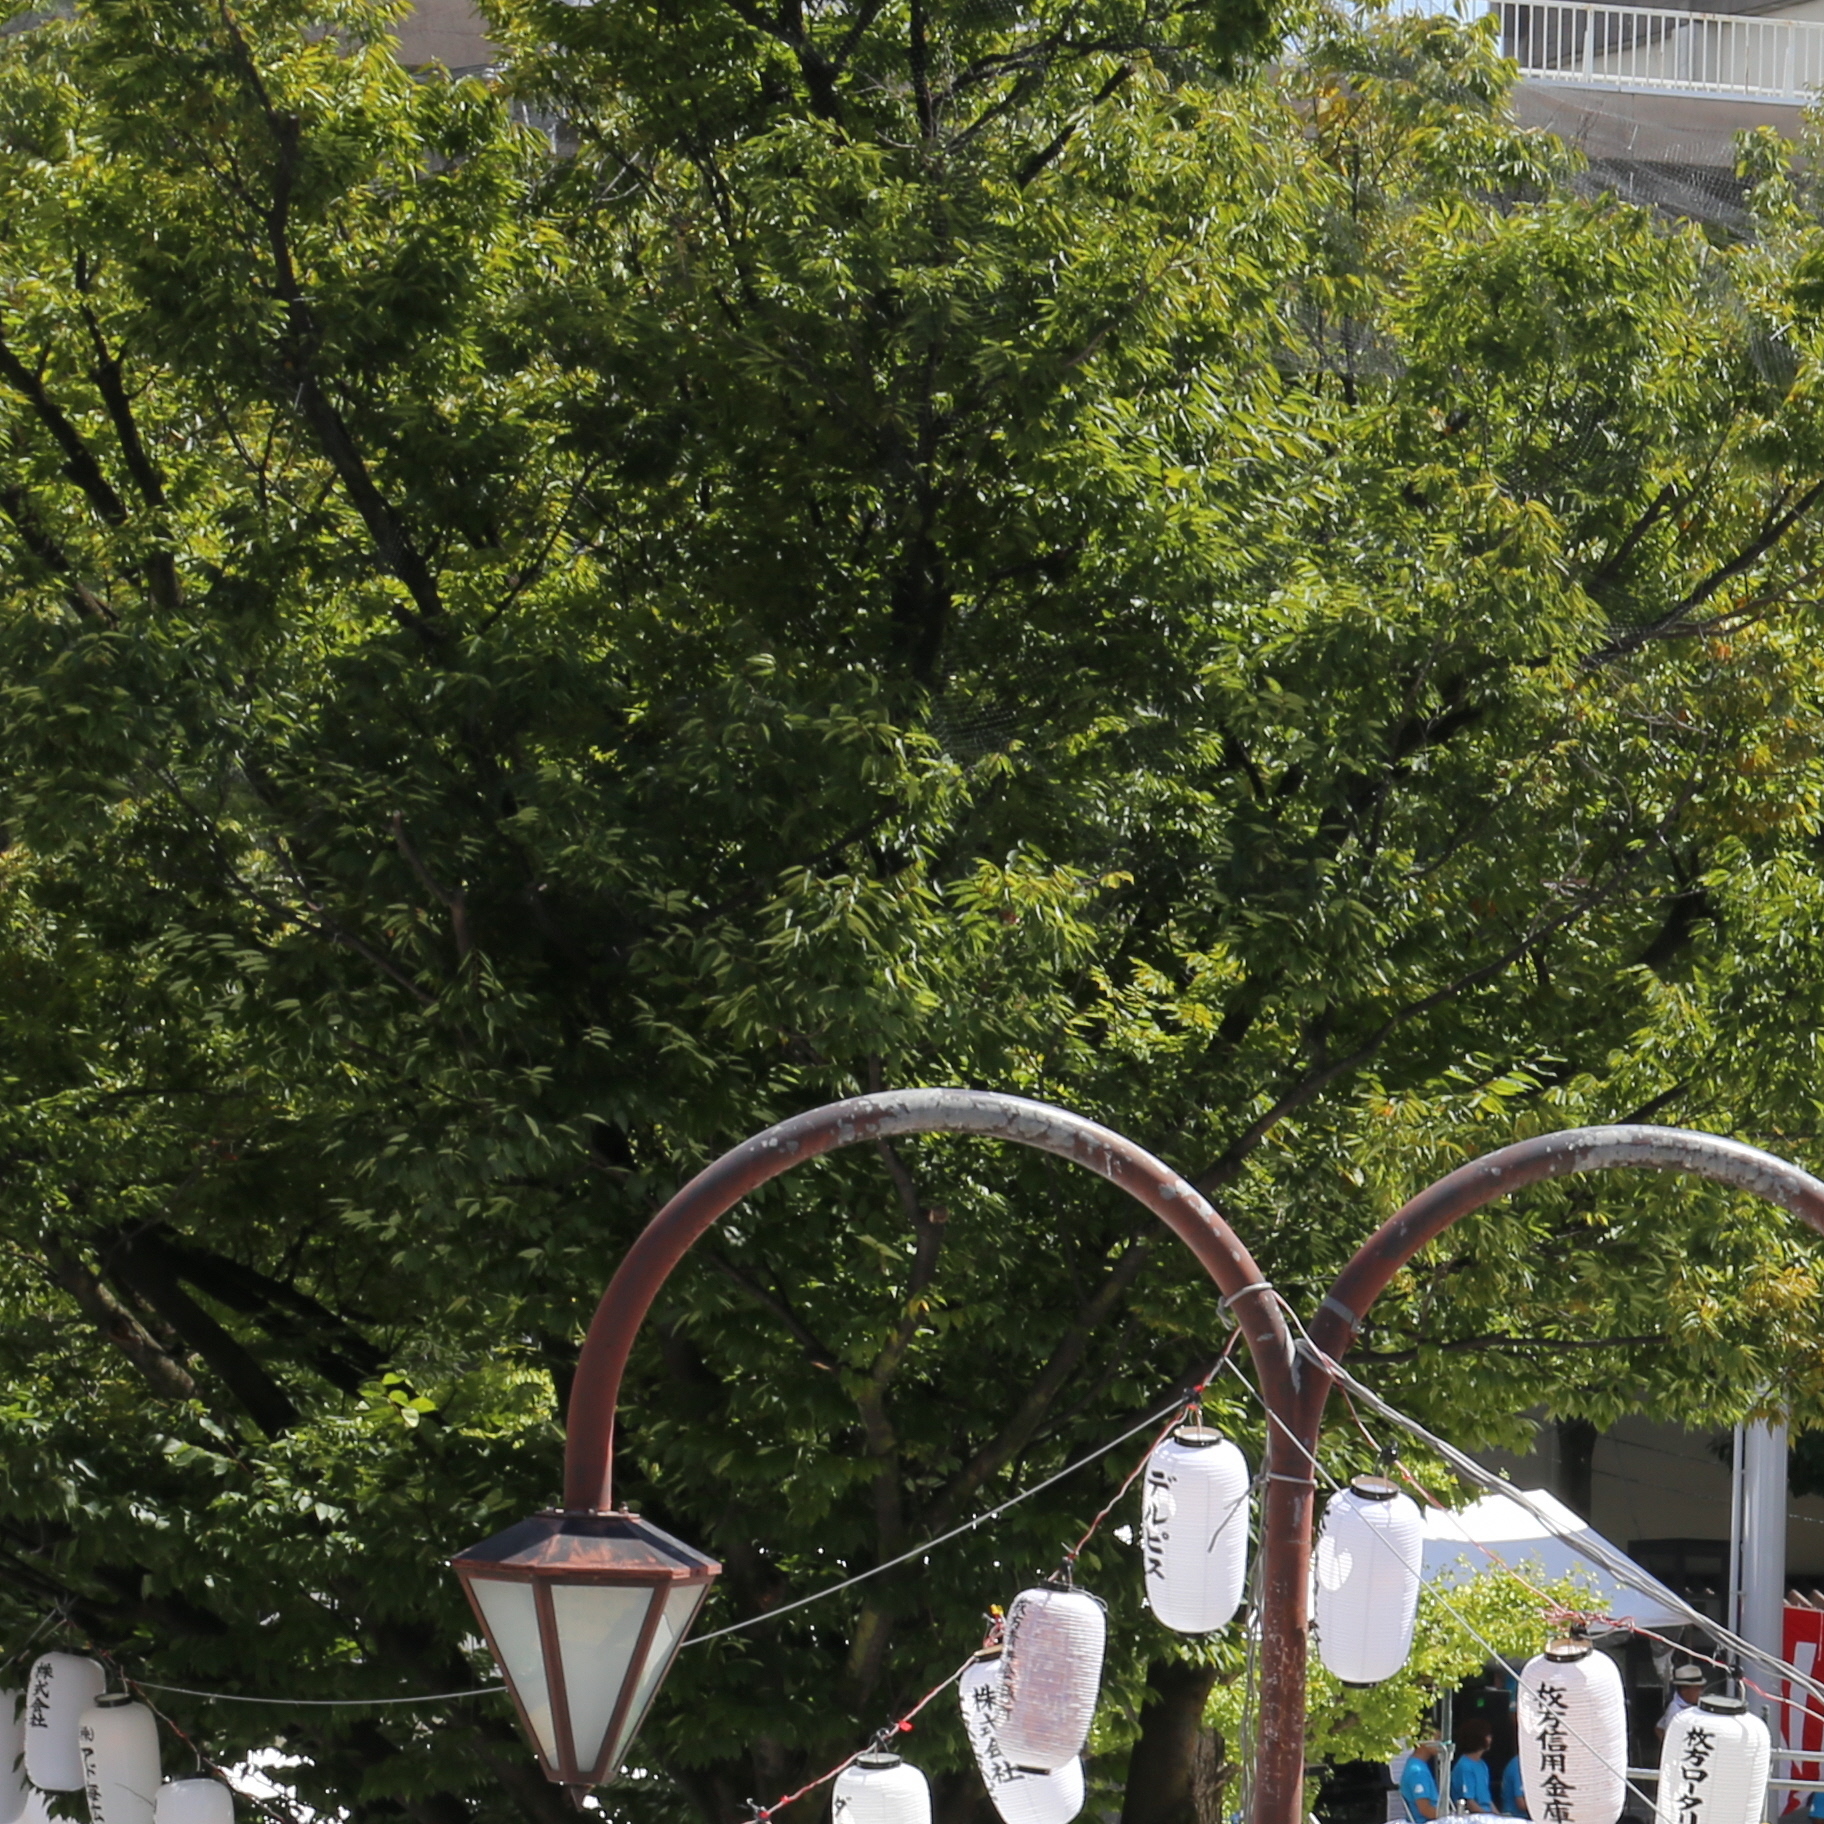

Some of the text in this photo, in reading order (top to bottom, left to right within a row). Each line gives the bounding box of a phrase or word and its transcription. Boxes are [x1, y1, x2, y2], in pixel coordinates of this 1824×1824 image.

[1146, 1470, 1180, 1580] デルピス
[26, 1662, 54, 1729] 株式会社
